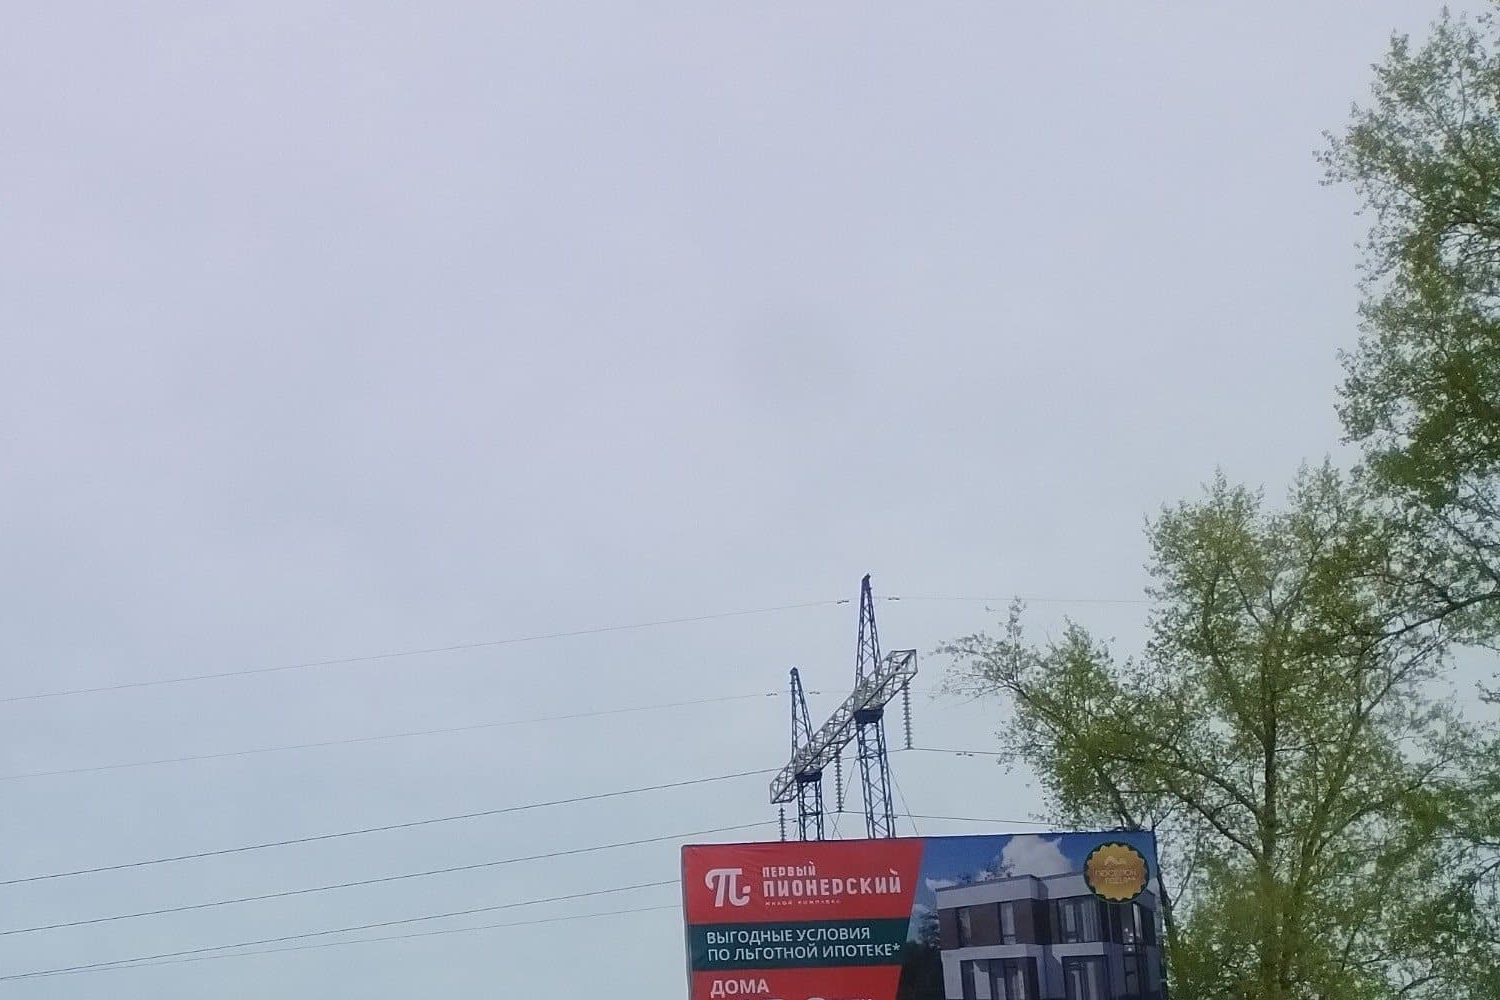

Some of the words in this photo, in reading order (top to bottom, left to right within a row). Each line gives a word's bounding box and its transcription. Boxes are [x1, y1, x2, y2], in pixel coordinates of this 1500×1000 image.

[762, 860, 816, 878] ПЕРВЫЙ
[763, 868, 901, 897] ПИОНЕРСКИЙ
[706, 929, 792, 945] ВЫГОДНЫЕ
[797, 927, 870, 942] УСЛОВИЯ
[708, 949, 730, 961] ПО
[733, 943, 818, 961] ЛЬГОТНОЙ
[710, 978, 769, 998] ДОМА
